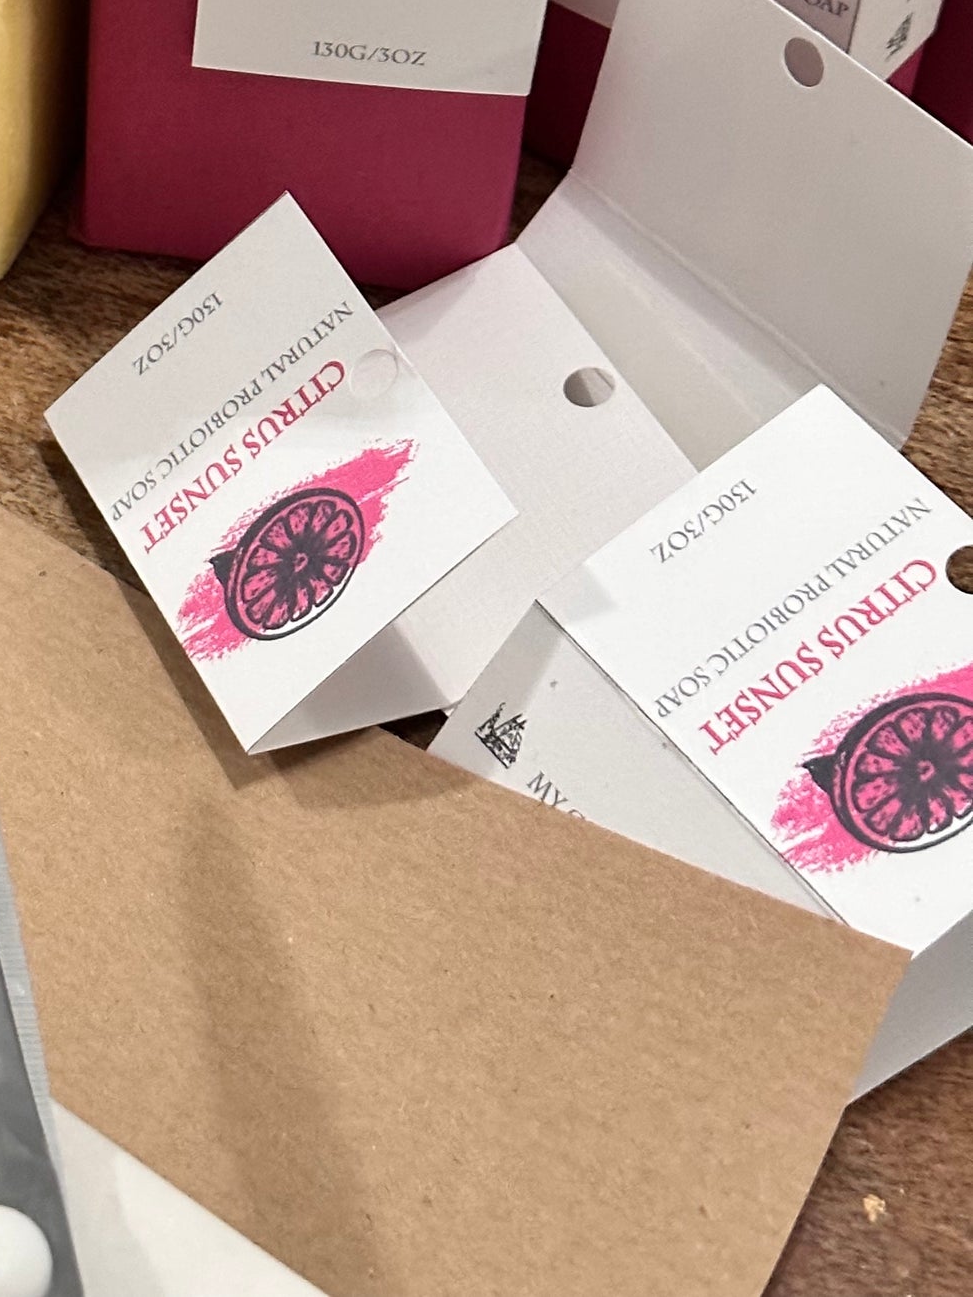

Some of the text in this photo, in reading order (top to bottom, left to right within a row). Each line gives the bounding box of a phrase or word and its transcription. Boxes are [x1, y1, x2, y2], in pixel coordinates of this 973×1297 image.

[111, 301, 355, 522] NATURAL PROBIOTIC SOAP
[139, 359, 346, 555] CITRUS SUNSET
[653, 497, 934, 719] NATURAL PROBIOTIC SOAP
[698, 559, 937, 756] CITRUS SUNSET
